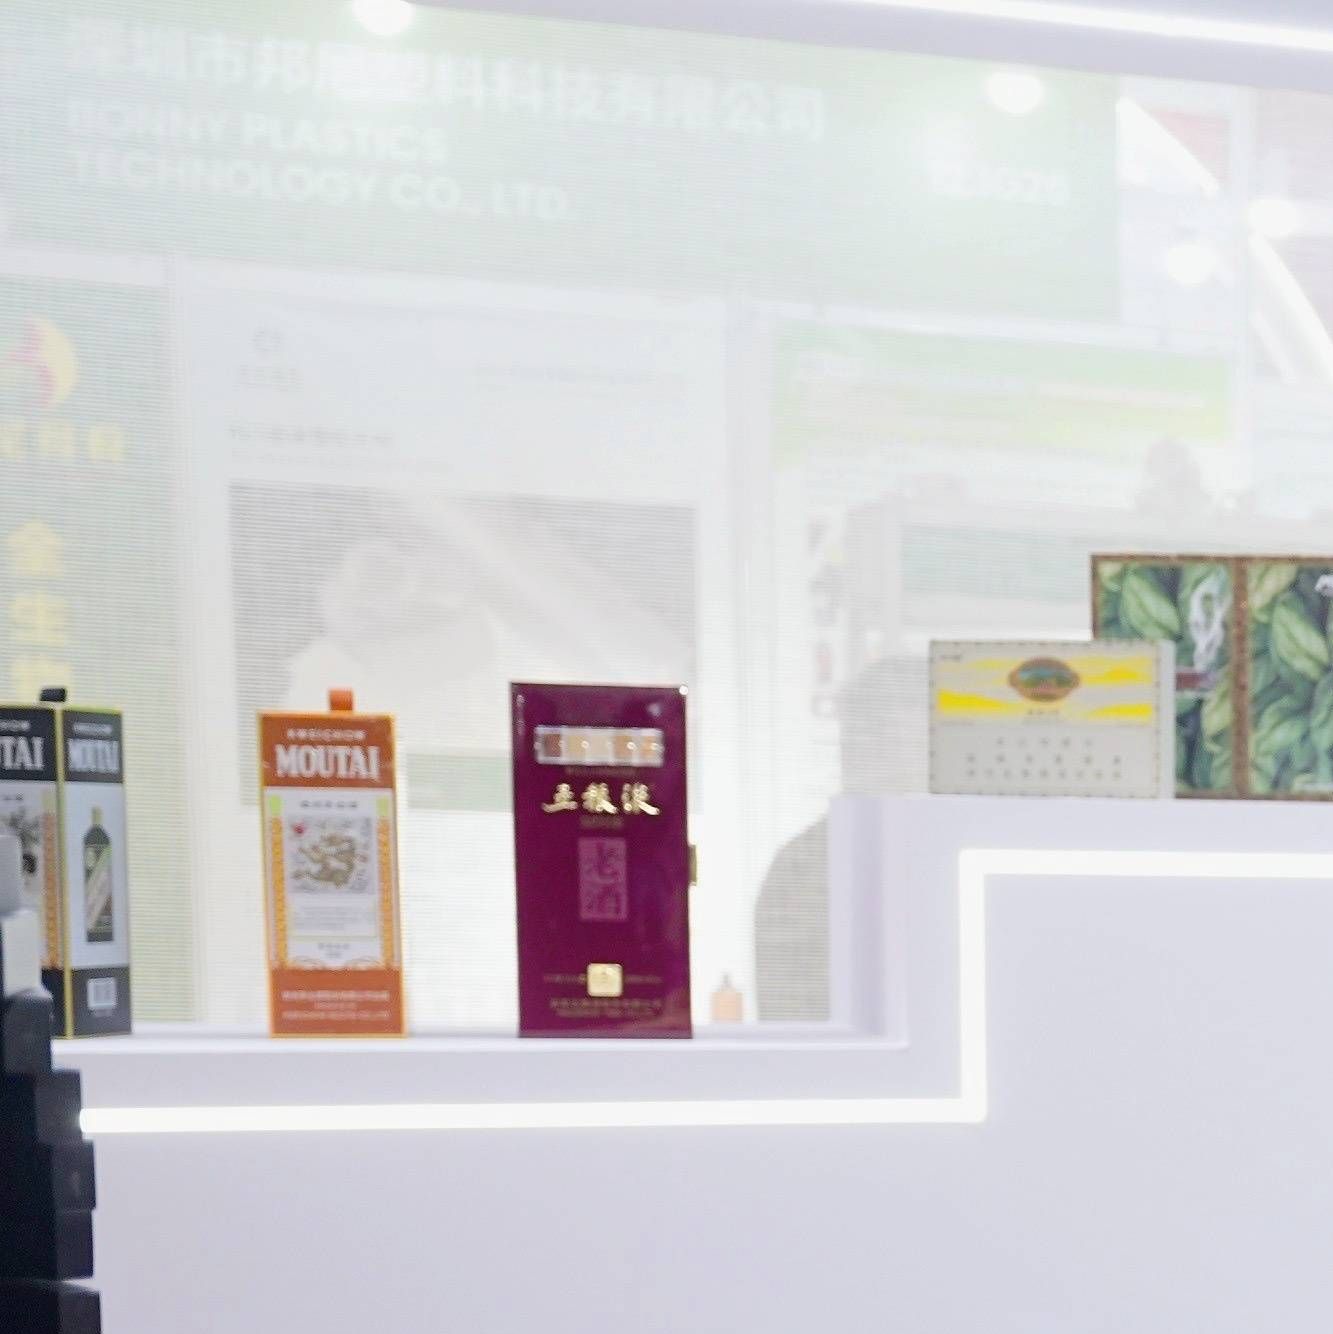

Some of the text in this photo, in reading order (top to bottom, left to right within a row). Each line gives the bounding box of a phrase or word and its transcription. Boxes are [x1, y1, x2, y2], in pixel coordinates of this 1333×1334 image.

[240, 110, 450, 167] PLASTICS
[67, 147, 380, 210] TECHNOLOGY
[274, 744, 380, 781] MOUTAI
